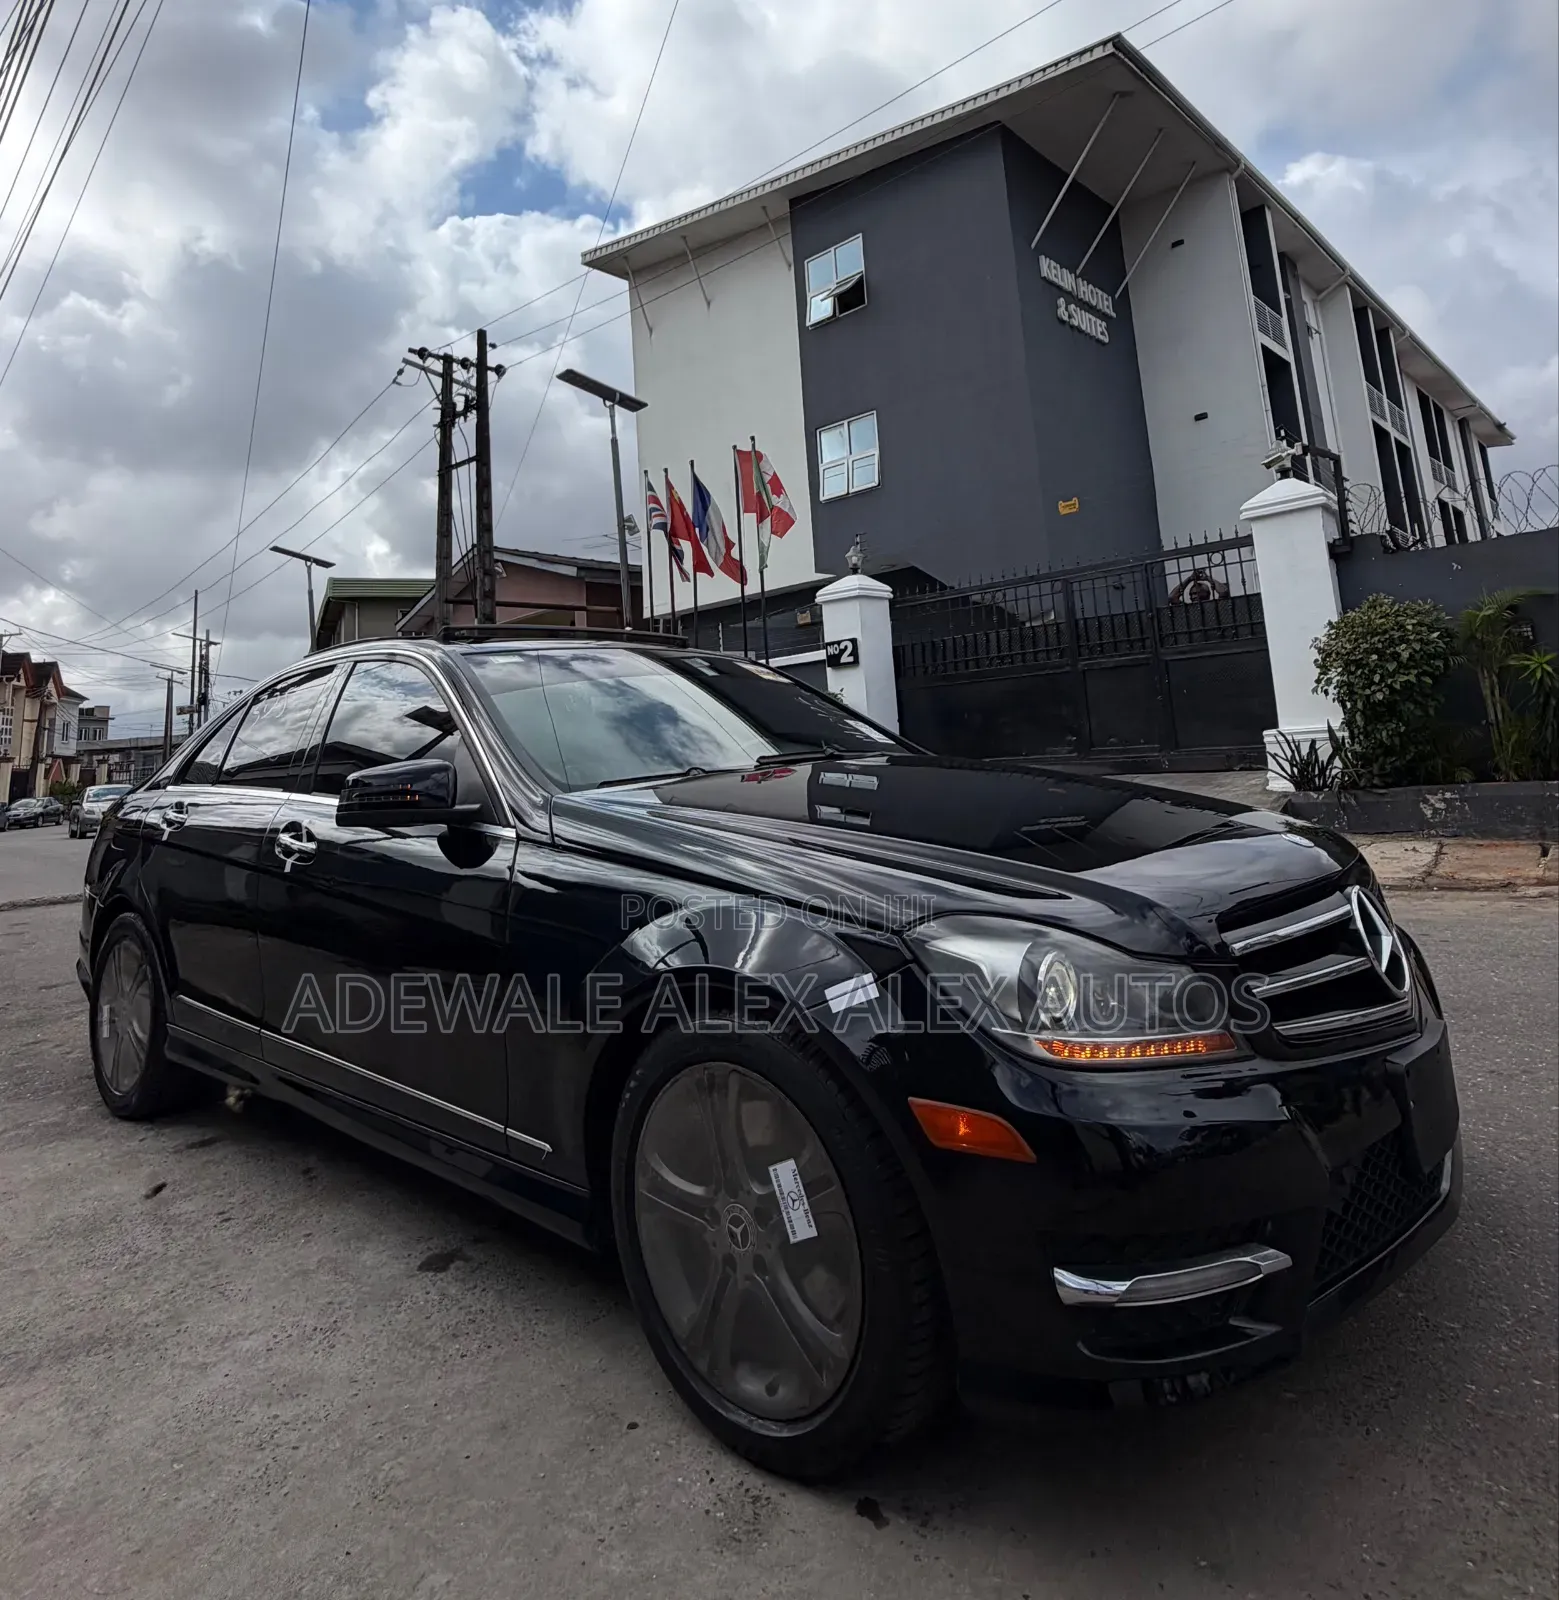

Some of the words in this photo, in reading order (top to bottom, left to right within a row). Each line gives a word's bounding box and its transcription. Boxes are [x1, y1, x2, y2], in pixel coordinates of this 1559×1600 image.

[1039, 254, 1077, 297] KELIN
[1076, 277, 1117, 318] HOTEL
[1057, 297, 1069, 322] &
[1068, 303, 1109, 343] SUITES
[840, 640, 855, 663] 2
[791, 1168, 813, 1228] Mercedes-Benz
